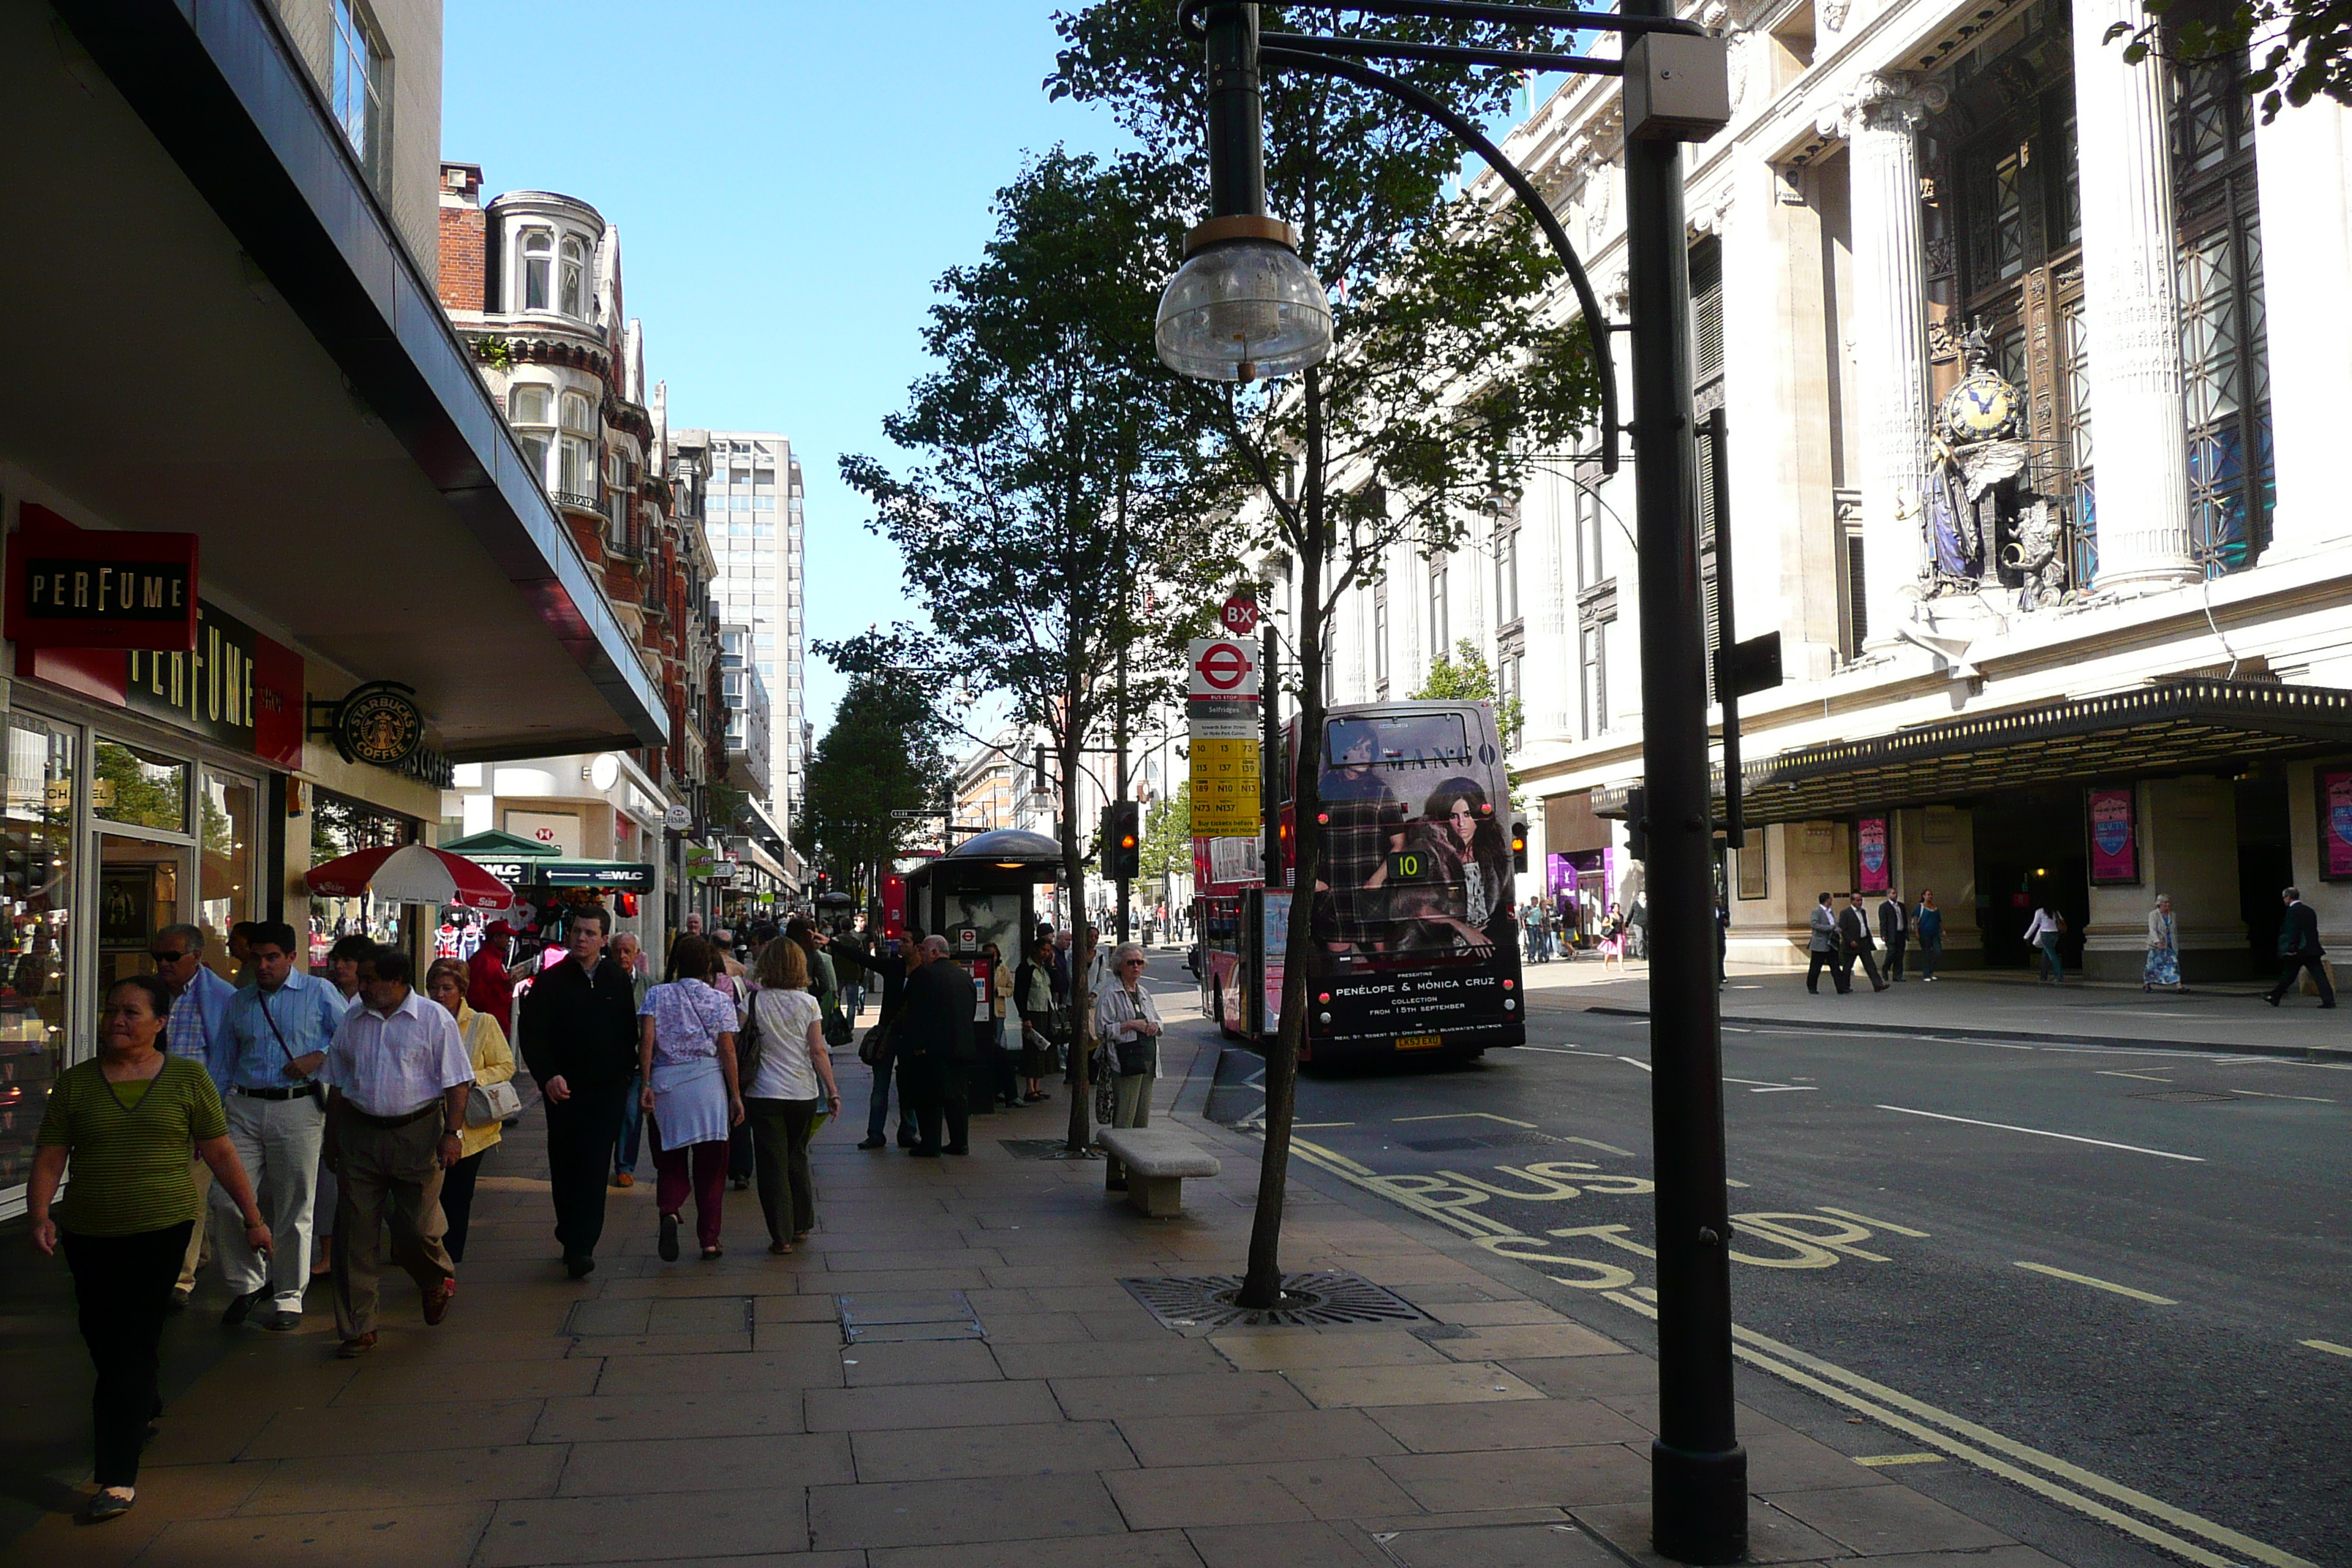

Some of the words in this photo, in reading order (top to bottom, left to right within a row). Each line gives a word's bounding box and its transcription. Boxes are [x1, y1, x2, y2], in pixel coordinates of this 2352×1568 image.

[32, 568, 181, 611] PERFUME
[1227, 606, 1253, 623] BX
[351, 698, 415, 728] STARBUCKS
[356, 741, 407, 760] COFFEE
[1387, 743, 1496, 772] MANGO
[48, 788, 108, 800] CHEL
[1399, 856, 1417, 875] 10
[611, 871, 644, 880] WLC
[478, 897, 497, 908] Sun
[1336, 984, 1395, 997] PENÉLOPE
[1401, 982, 1411, 992] &
[1417, 979, 1459, 991] MÓNICA
[1465, 977, 1496, 987] CRUZ
[1391, 996, 1438, 1006] COLLECTION
[1396, 1006, 1417, 1014] 15TH
[1420, 1003, 1466, 1013] SEPTEMBER
[1399, 1039, 1420, 1047] LK53
[1368, 1161, 1655, 1208] BUS
[1474, 1211, 1891, 1289] STOP
